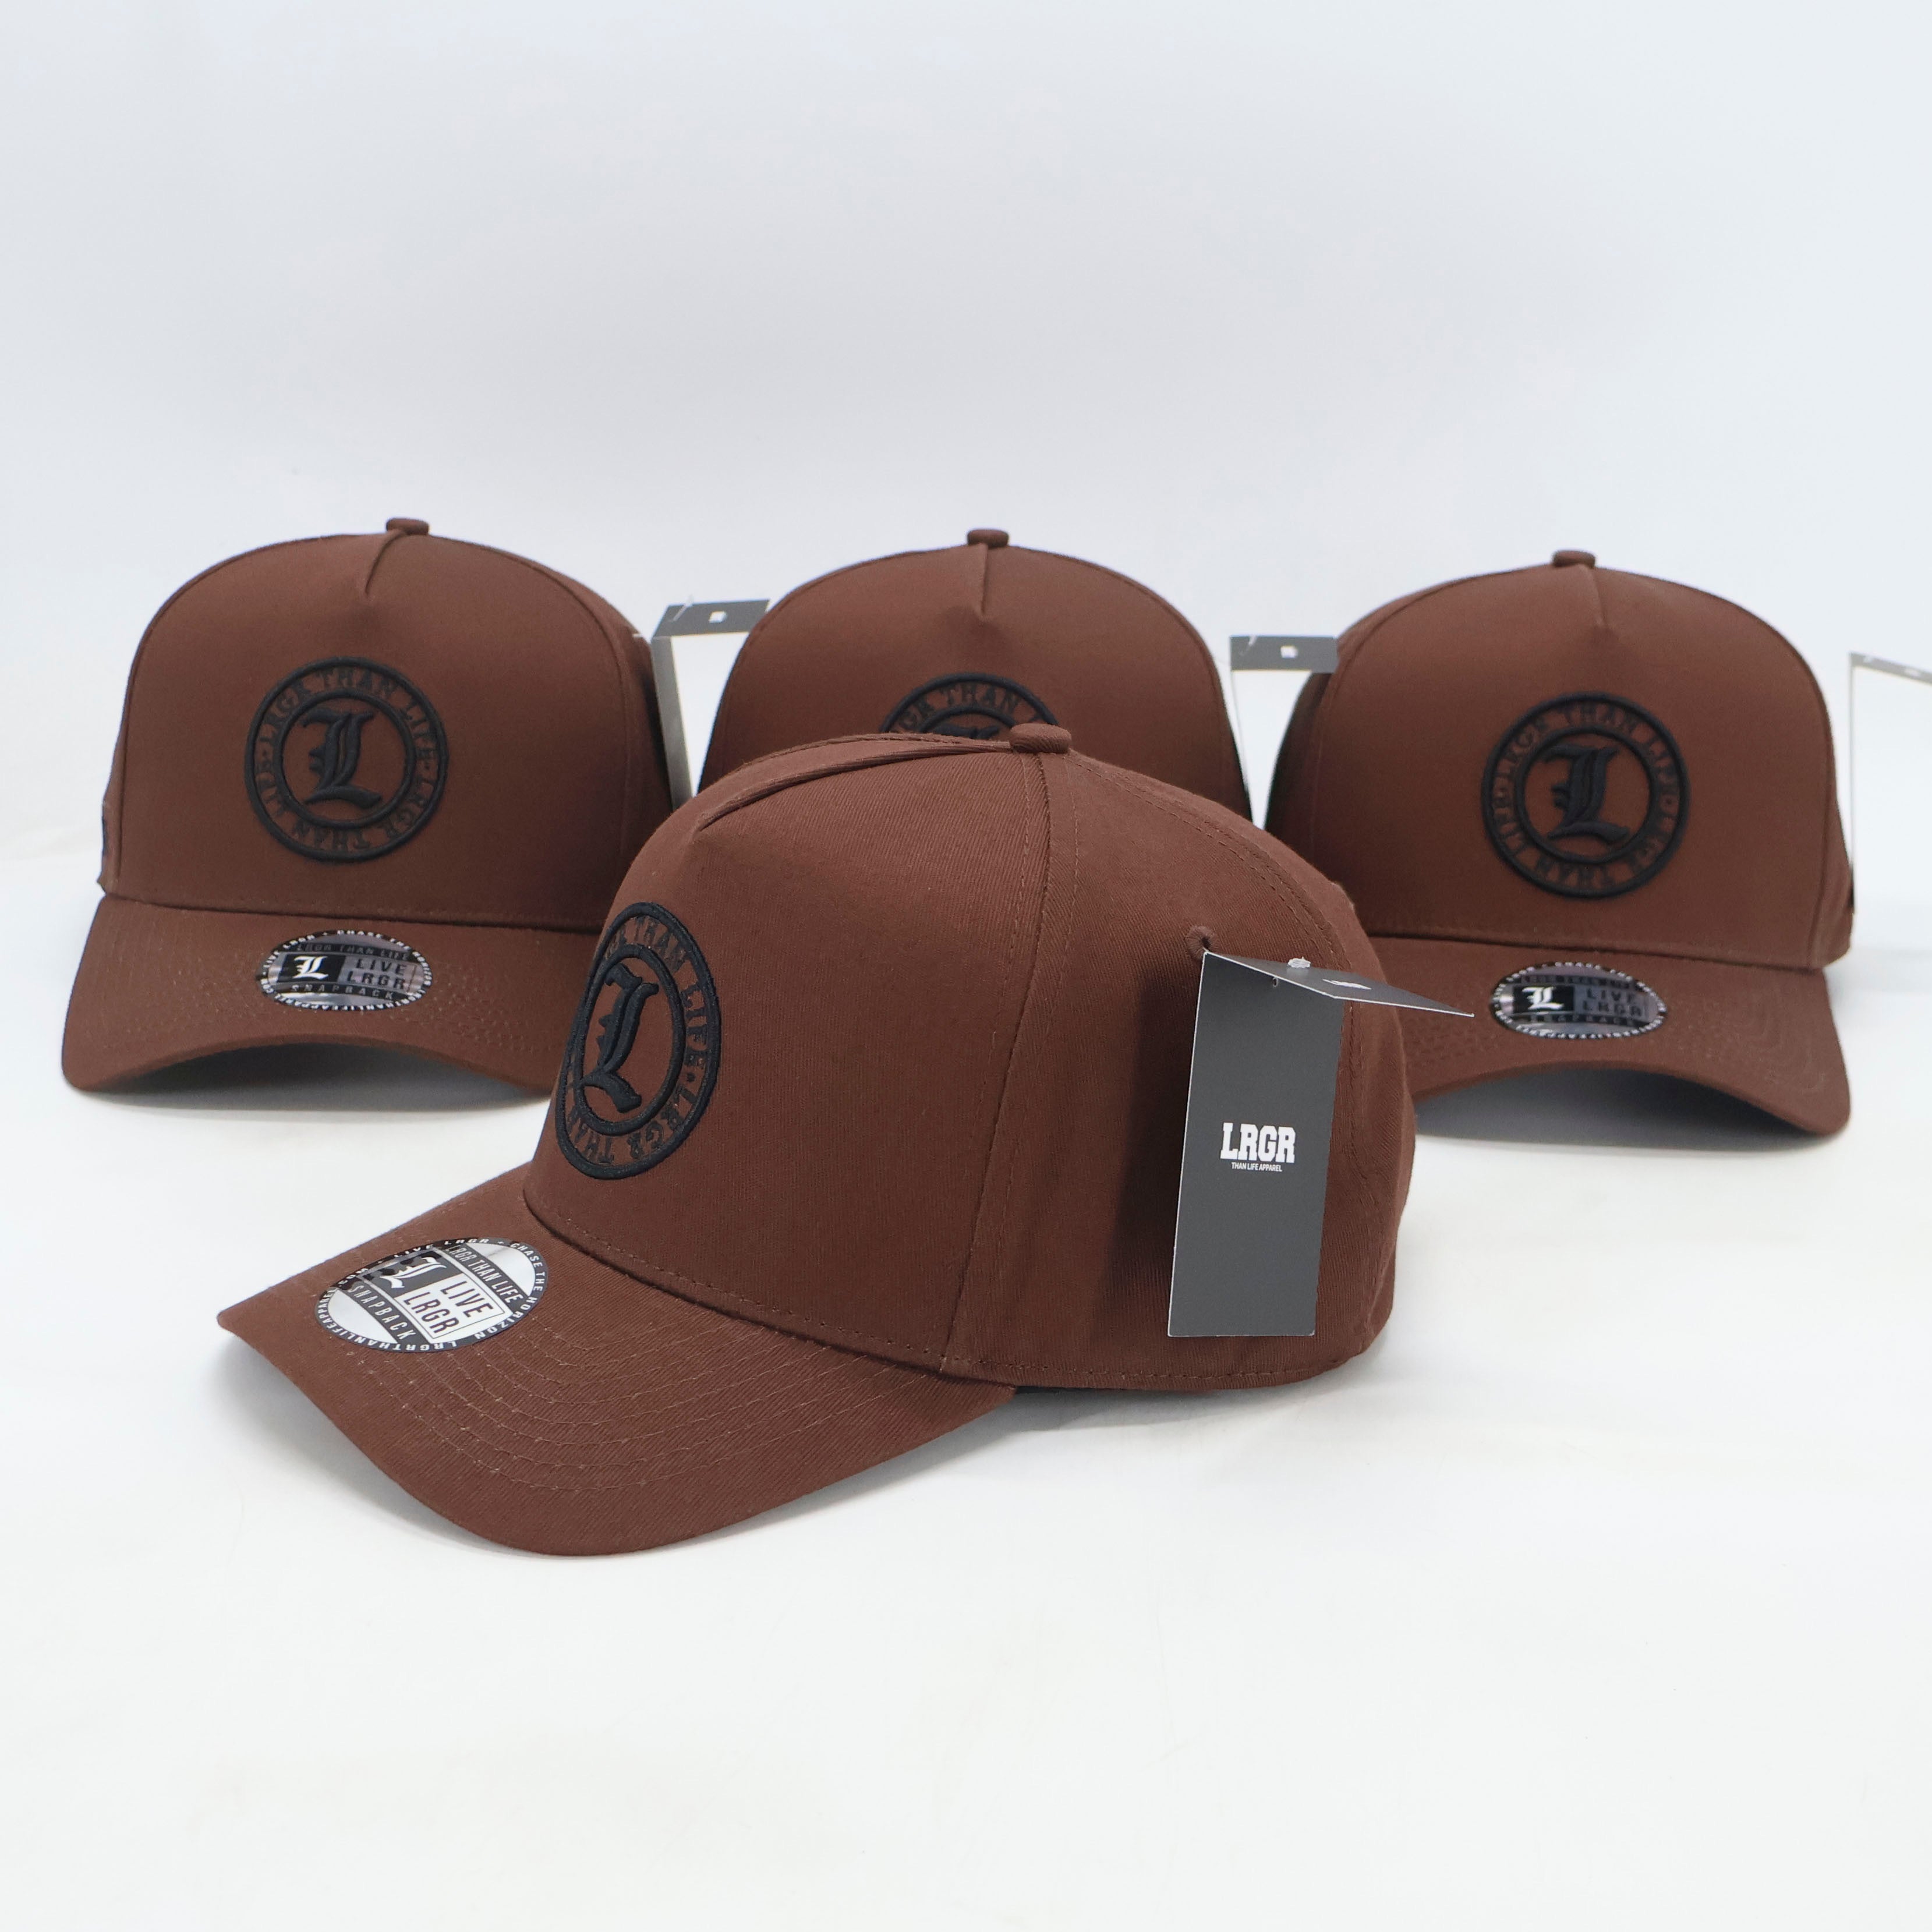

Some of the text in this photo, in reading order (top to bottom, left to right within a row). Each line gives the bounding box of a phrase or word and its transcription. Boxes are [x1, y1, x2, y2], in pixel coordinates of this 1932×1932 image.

[292, 956, 328, 979] L
[347, 971, 405, 989] LRGR
[356, 958, 406, 975] LIVE
[1220, 1122, 1296, 1163] LRGR
[1231, 1162, 1247, 1170] THAN
[1259, 1163, 1283, 1172] APPAREL
[510, 1243, 543, 1268] CHASE
[380, 1257, 447, 1289] L
[445, 1244, 524, 1304] LRGR THAN LIFE
[533, 1271, 545, 1292] THE
[348, 1285, 416, 1340] SNAPBACK
[404, 1291, 460, 1334] LRGR
[440, 1281, 494, 1318] LIVE
[474, 1296, 537, 1340] HORIZON
